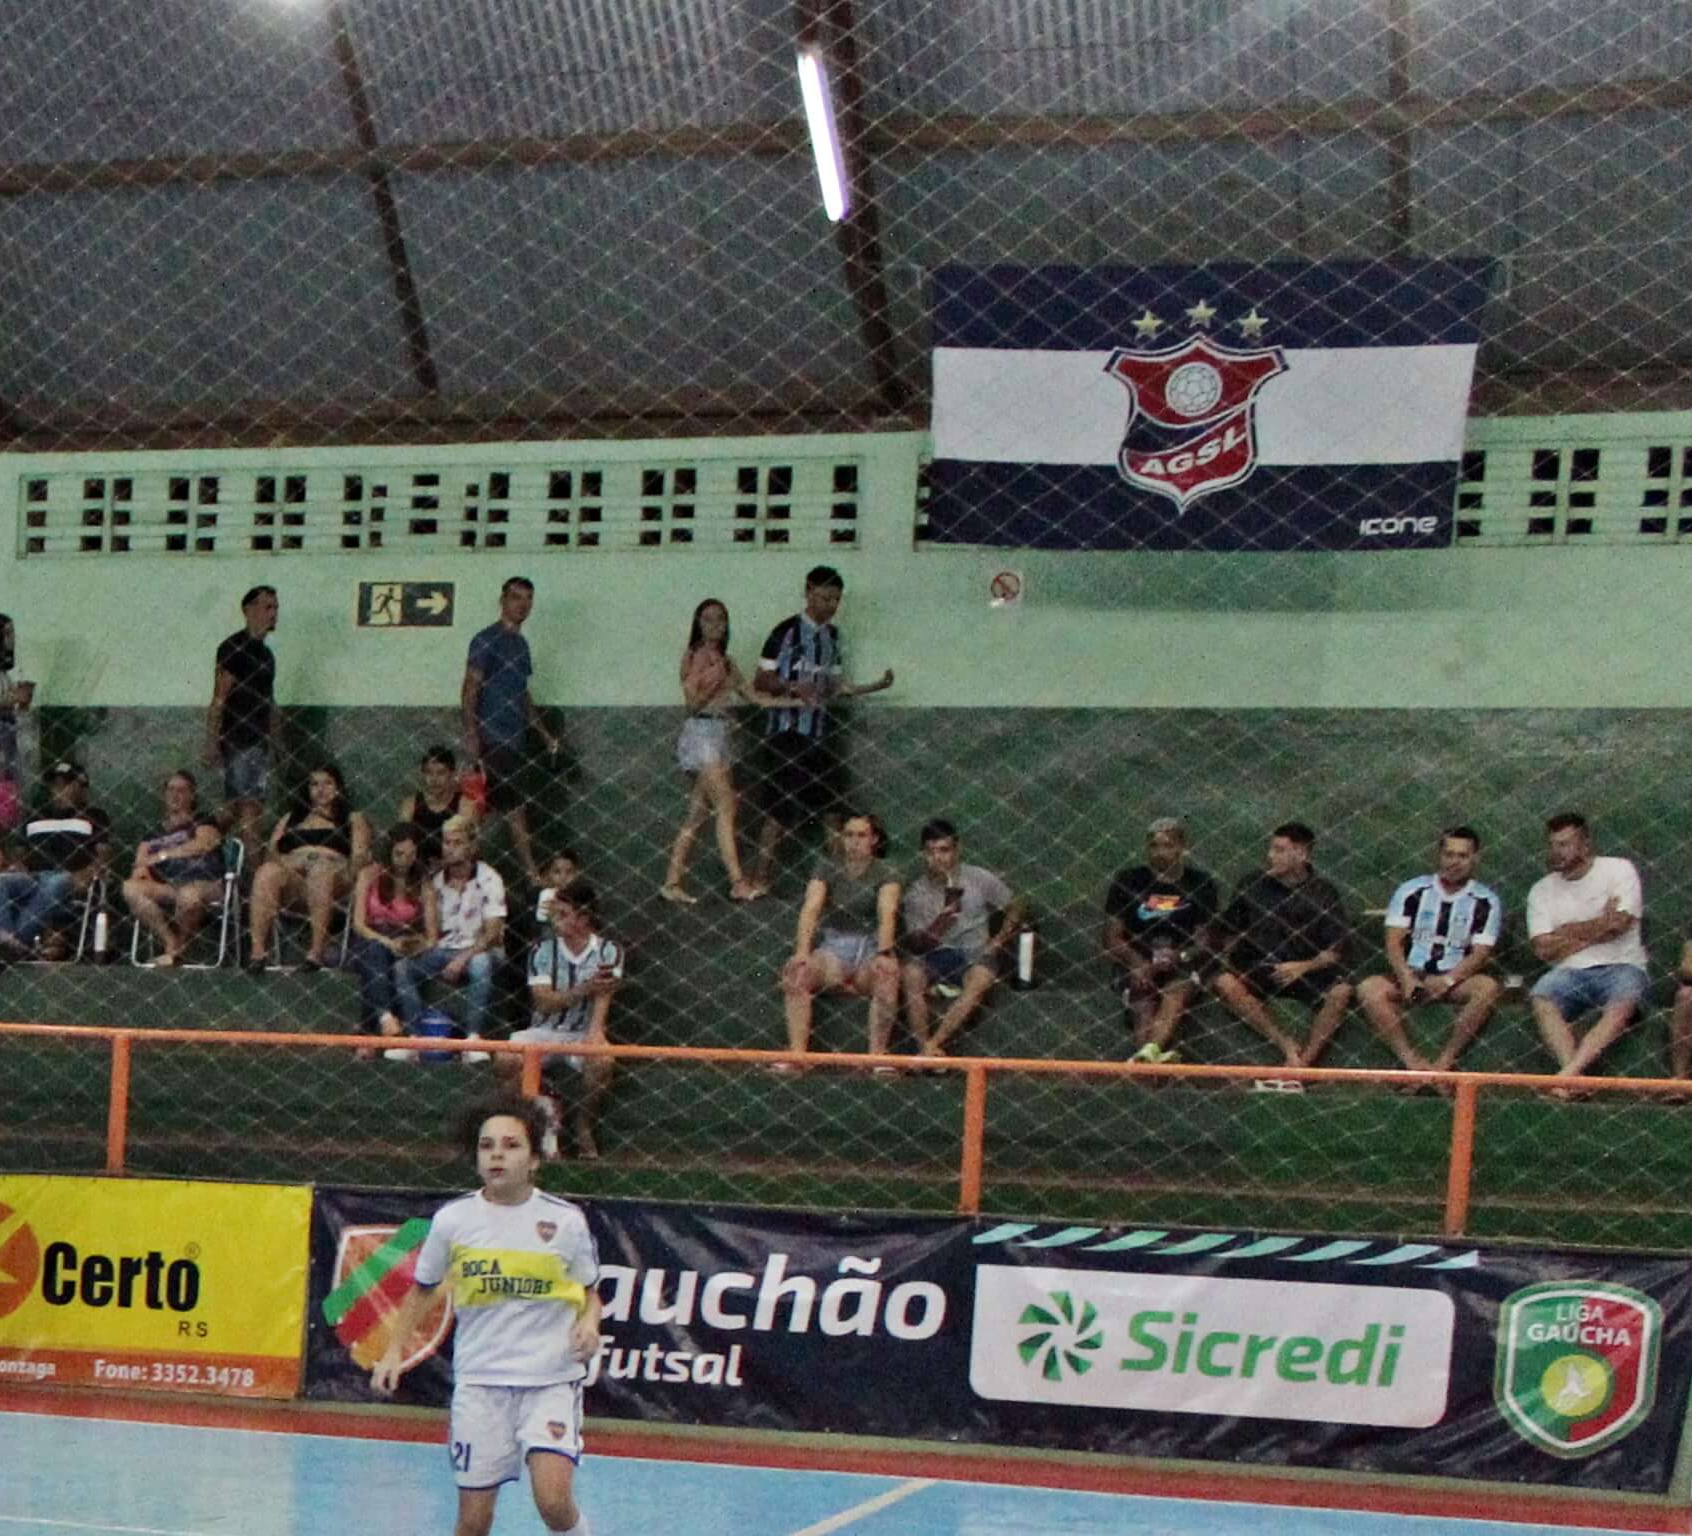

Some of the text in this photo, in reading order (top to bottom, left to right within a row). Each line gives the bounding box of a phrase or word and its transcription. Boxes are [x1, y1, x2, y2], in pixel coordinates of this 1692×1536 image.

[1140, 426, 1250, 477] AGSL
[41, 1241, 200, 1313] Certo
[461, 1259, 502, 1277] BOCA
[477, 1275, 554, 1295] JUNIORS
[596, 1253, 947, 1341] auchão
[1556, 1303, 1606, 1321] LIGA
[1119, 1310, 1406, 1388] Sicredi
[1526, 1321, 1633, 1346] GAÚCHA
[152, 1362, 255, 1388] 3352.3478
[582, 1335, 744, 1388] futsal
[452, 1441, 472, 1473] 21
